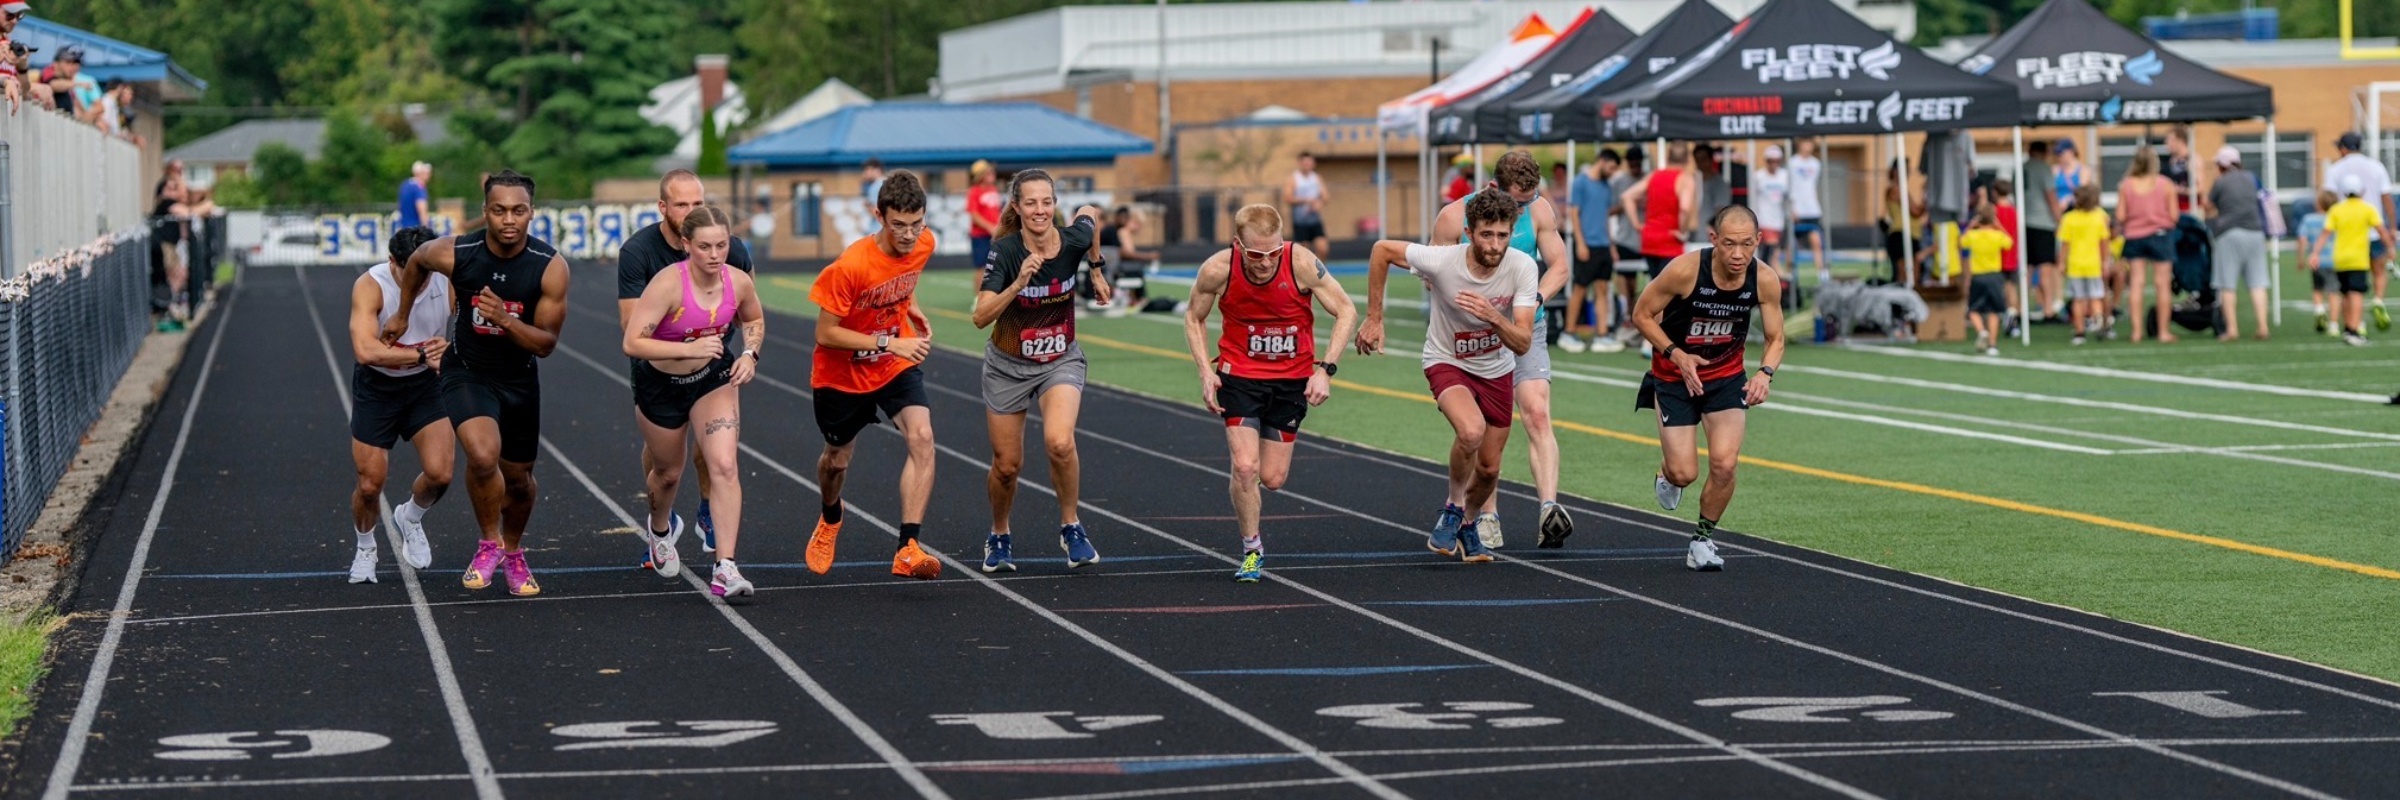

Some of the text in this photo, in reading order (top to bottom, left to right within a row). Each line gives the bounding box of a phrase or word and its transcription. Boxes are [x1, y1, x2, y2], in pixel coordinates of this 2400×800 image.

[1741, 44, 1861, 70] FLEET
[2016, 51, 2127, 78] FLEET
[1758, 58, 1858, 83] FEET
[2032, 68, 2119, 89] FEET
[1796, 95, 1970, 126] FLEET FEET
[2036, 99, 2174, 121] FLEET FEET
[1719, 115, 1767, 135] ELITE
[1692, 301, 1750, 312] CINCINNATUS
[1690, 322, 1733, 336] 6140
[1021, 334, 1067, 357] 6228
[1250, 334, 1295, 353] 6184
[1455, 333, 1501, 353] 6065
